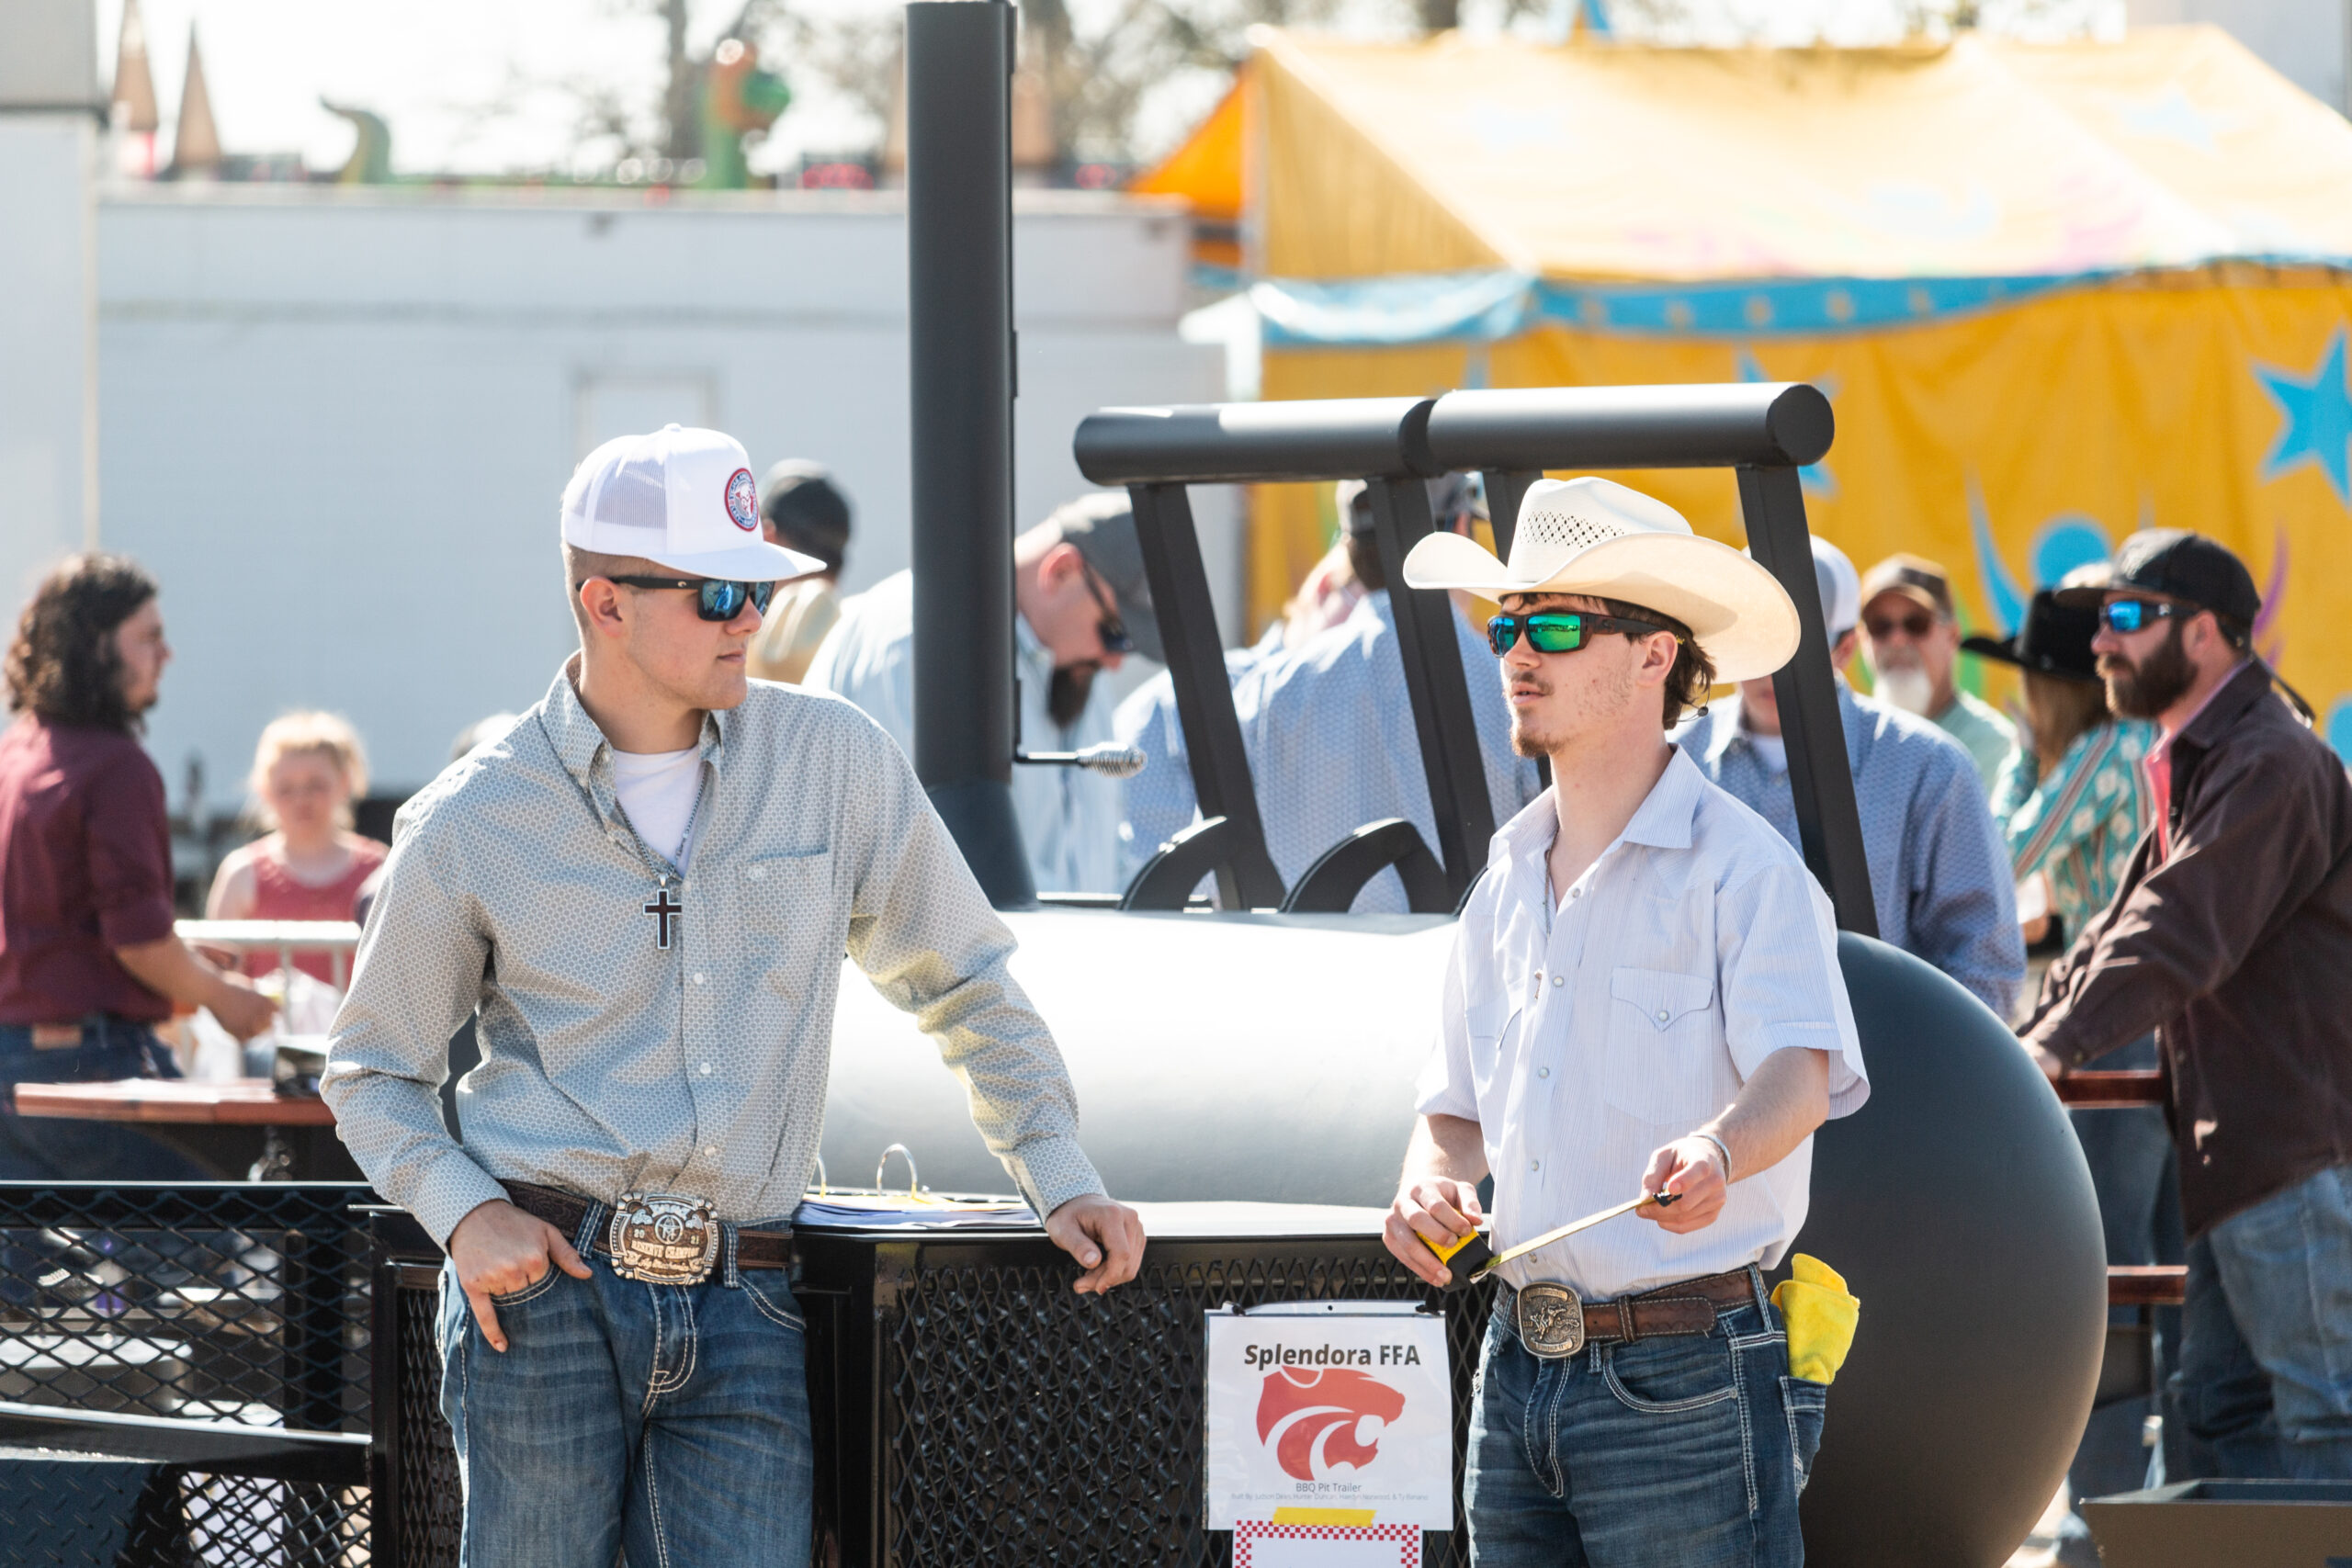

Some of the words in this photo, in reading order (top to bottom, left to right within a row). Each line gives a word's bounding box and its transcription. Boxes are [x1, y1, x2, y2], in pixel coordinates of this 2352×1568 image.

[1244, 1343, 1371, 1371] Splendora
[1380, 1345, 1420, 1365] FFA
[1295, 1483, 1316, 1493] BBQ
[1318, 1483, 1330, 1492] Pit
[1333, 1483, 1362, 1492] Trailer
